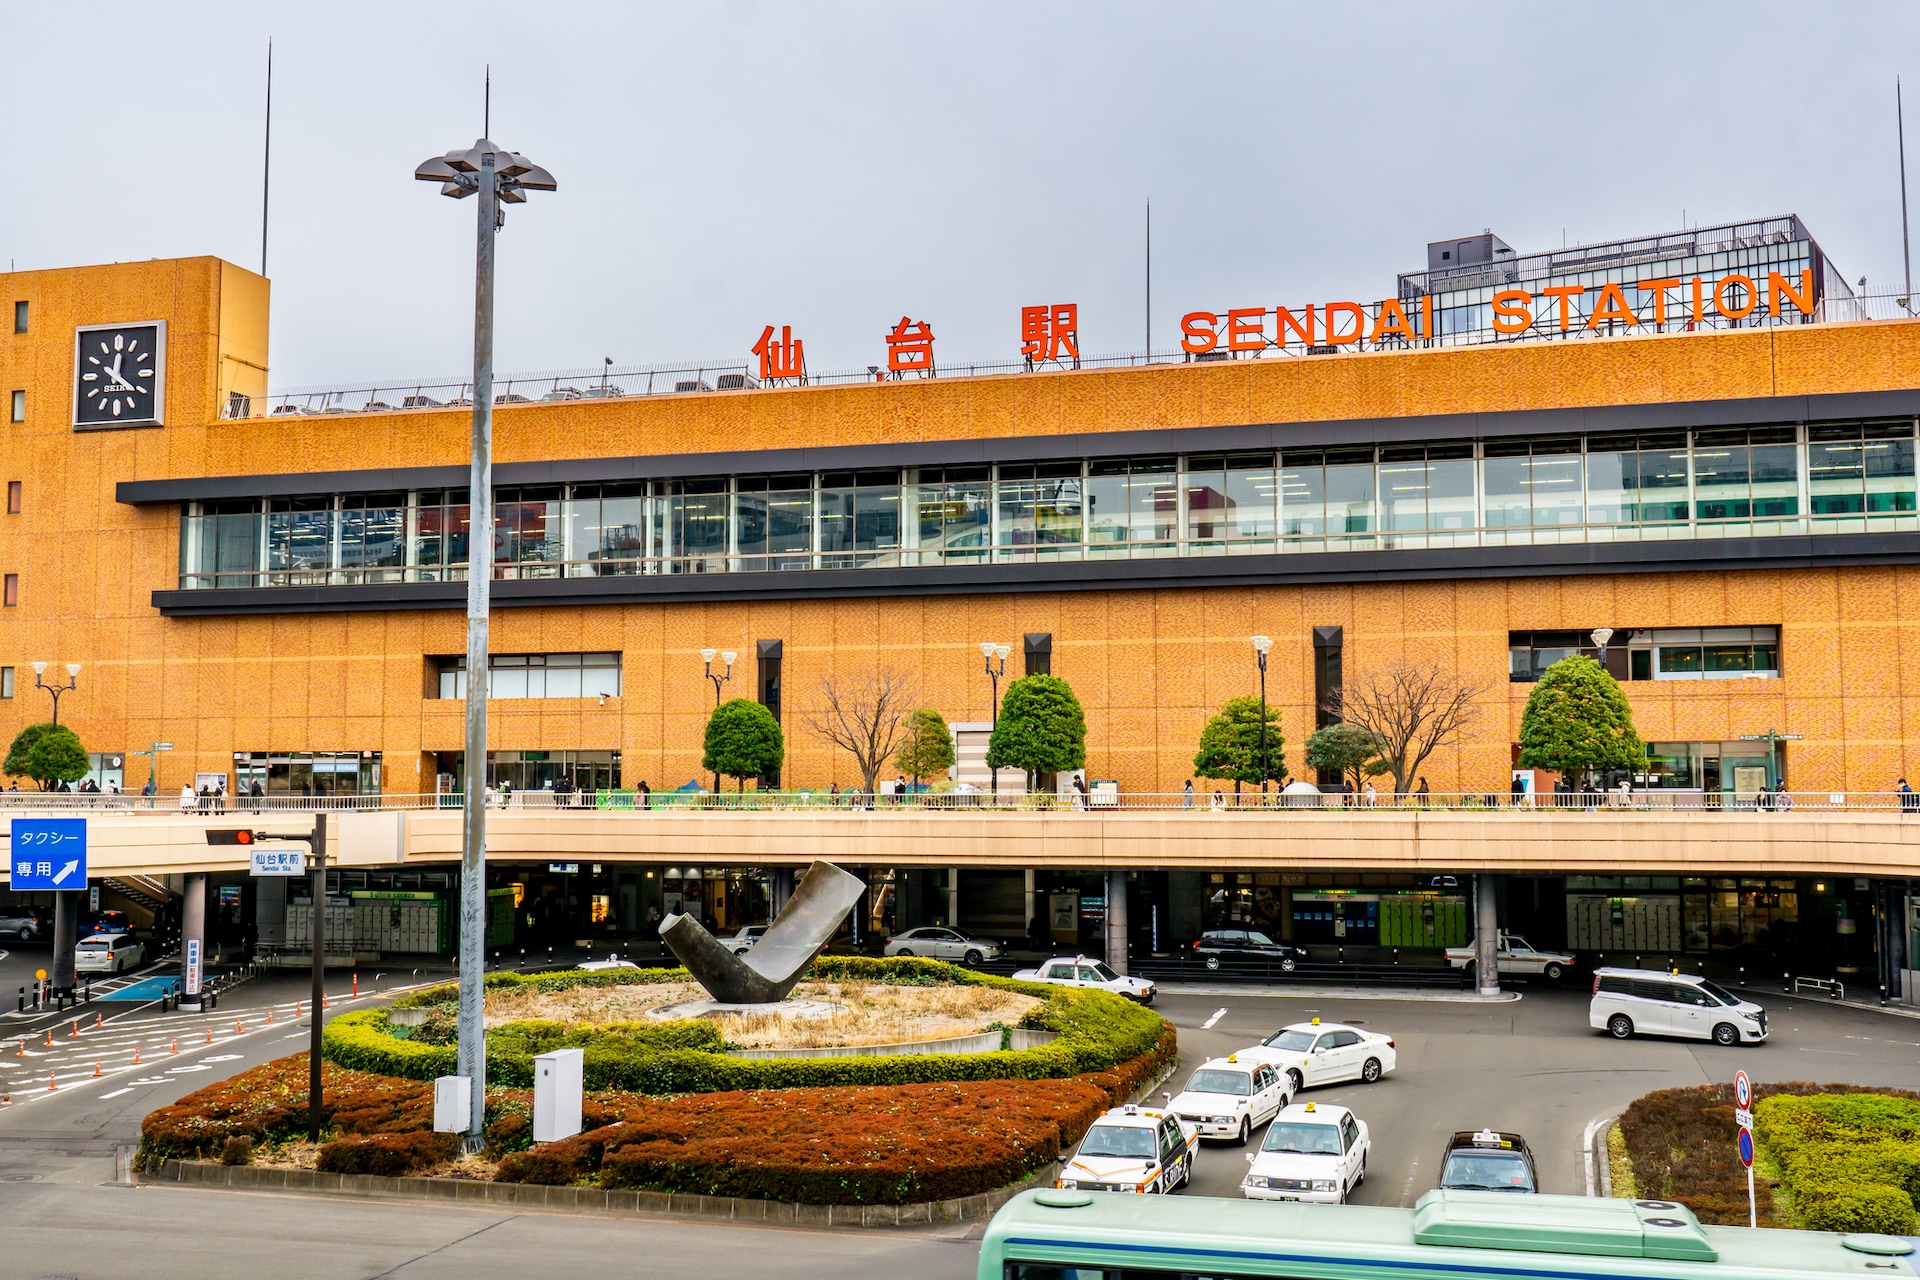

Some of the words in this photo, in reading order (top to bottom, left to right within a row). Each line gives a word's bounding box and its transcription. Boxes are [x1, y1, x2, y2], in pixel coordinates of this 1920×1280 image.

[1180, 295, 1433, 354] SENDAI
[1491, 269, 1815, 334] STATION
[751, 303, 1080, 380] 仙台駅
[103, 384, 130, 393] SEIK
[20, 831, 79, 845] タクシー
[255, 853, 299, 865] 仙台駅前
[16, 861, 52, 877] 専用
